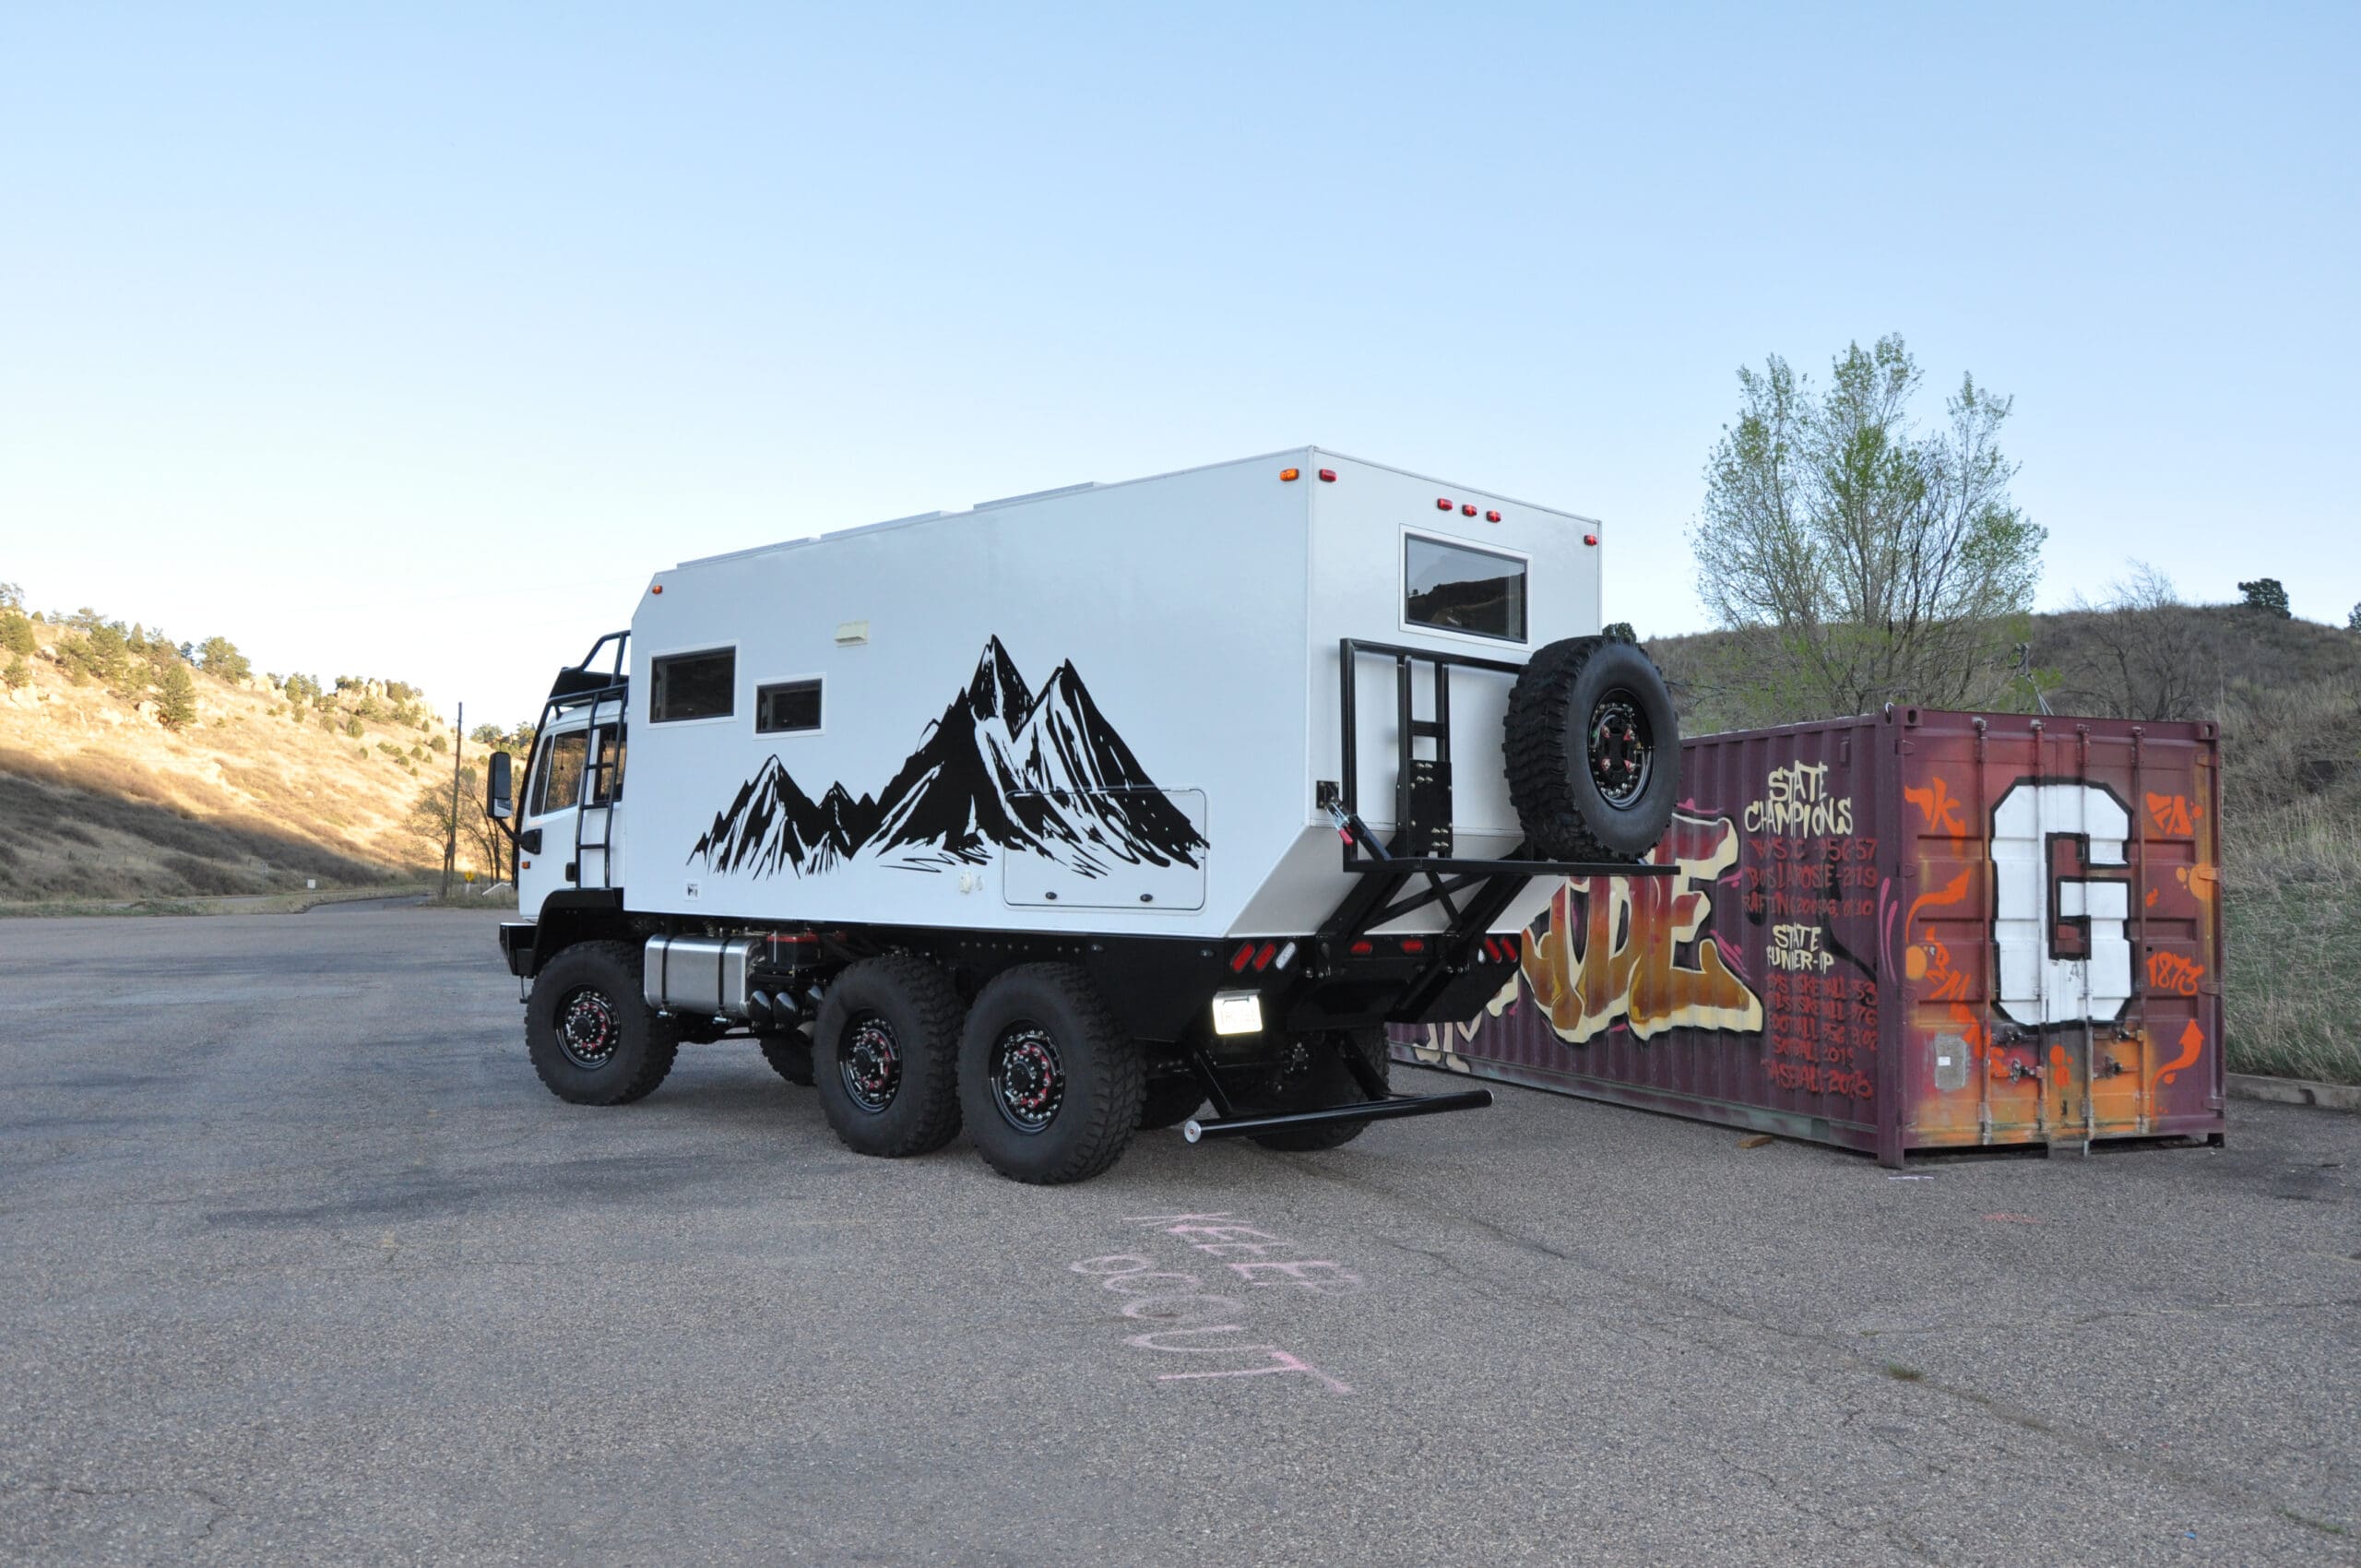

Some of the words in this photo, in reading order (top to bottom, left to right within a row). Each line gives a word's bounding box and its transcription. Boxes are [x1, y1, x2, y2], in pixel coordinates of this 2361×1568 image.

[1768, 759, 1828, 802] STATE
[1744, 797, 1854, 838] CHAMPIONS
[1989, 776, 2134, 1030] G
[1773, 922, 1821, 952] STATE
[2147, 952, 2205, 996] 1873
